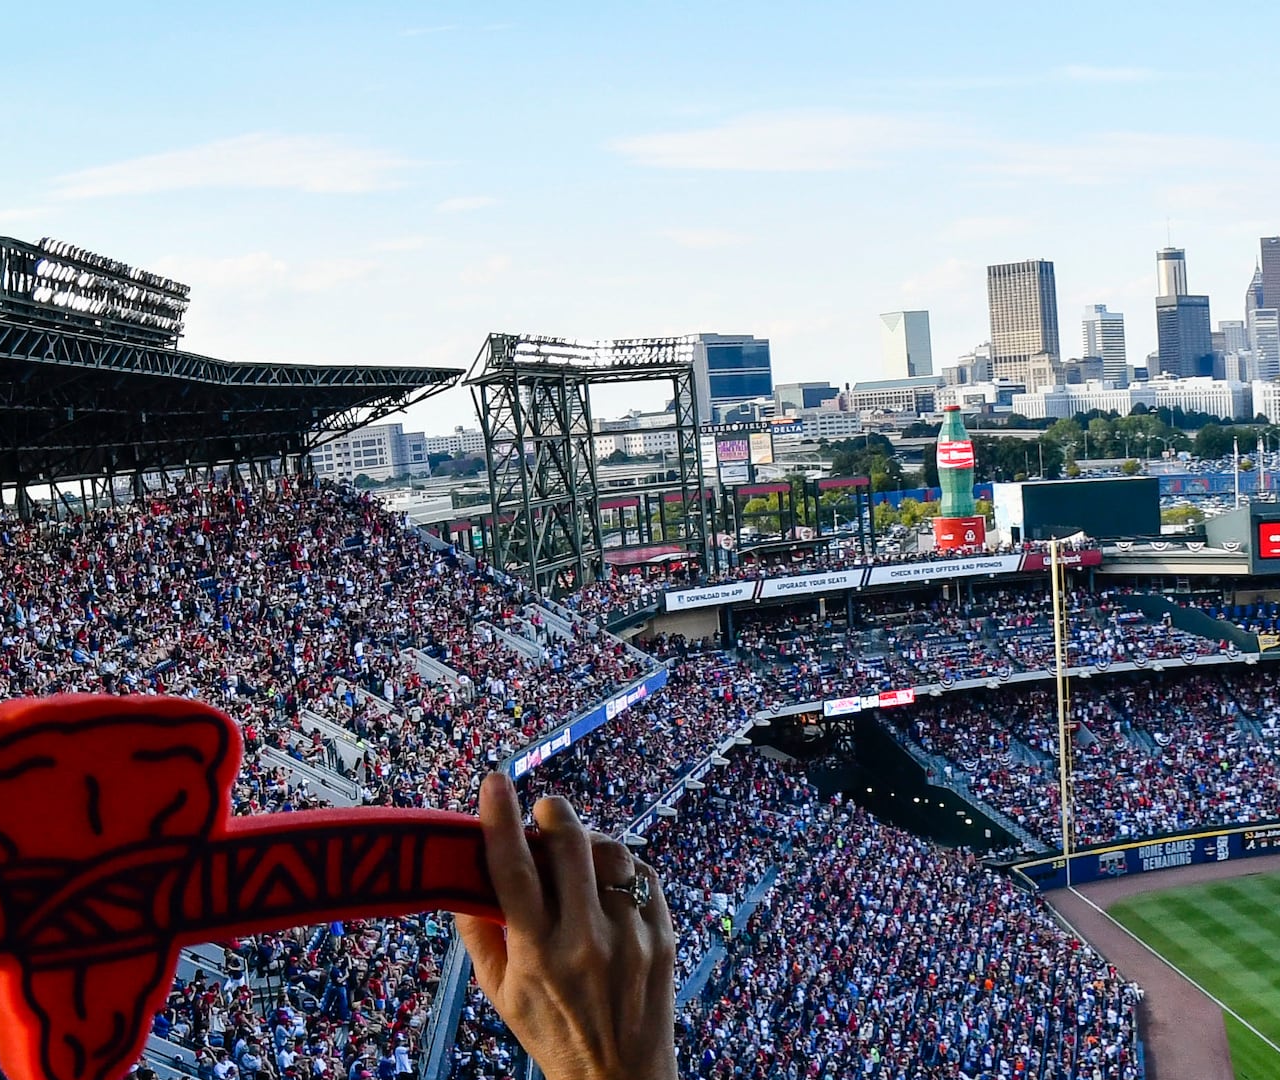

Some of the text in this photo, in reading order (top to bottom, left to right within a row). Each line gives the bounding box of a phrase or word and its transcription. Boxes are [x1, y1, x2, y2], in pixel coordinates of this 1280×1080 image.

[774, 425, 802, 433] DELTA
[890, 569, 911, 577] CHECK
[921, 566, 934, 575] FOR
[935, 564, 960, 573] OFFERS
[976, 561, 1003, 569] PROMOS
[777, 576, 847, 590] UPGRADE YOUR SEATS
[686, 592, 720, 603] DOWNLOAD
[731, 588, 743, 597] APP
[1138, 839, 1195, 859] HOME GAMES
[1143, 852, 1192, 871] REMAINING
